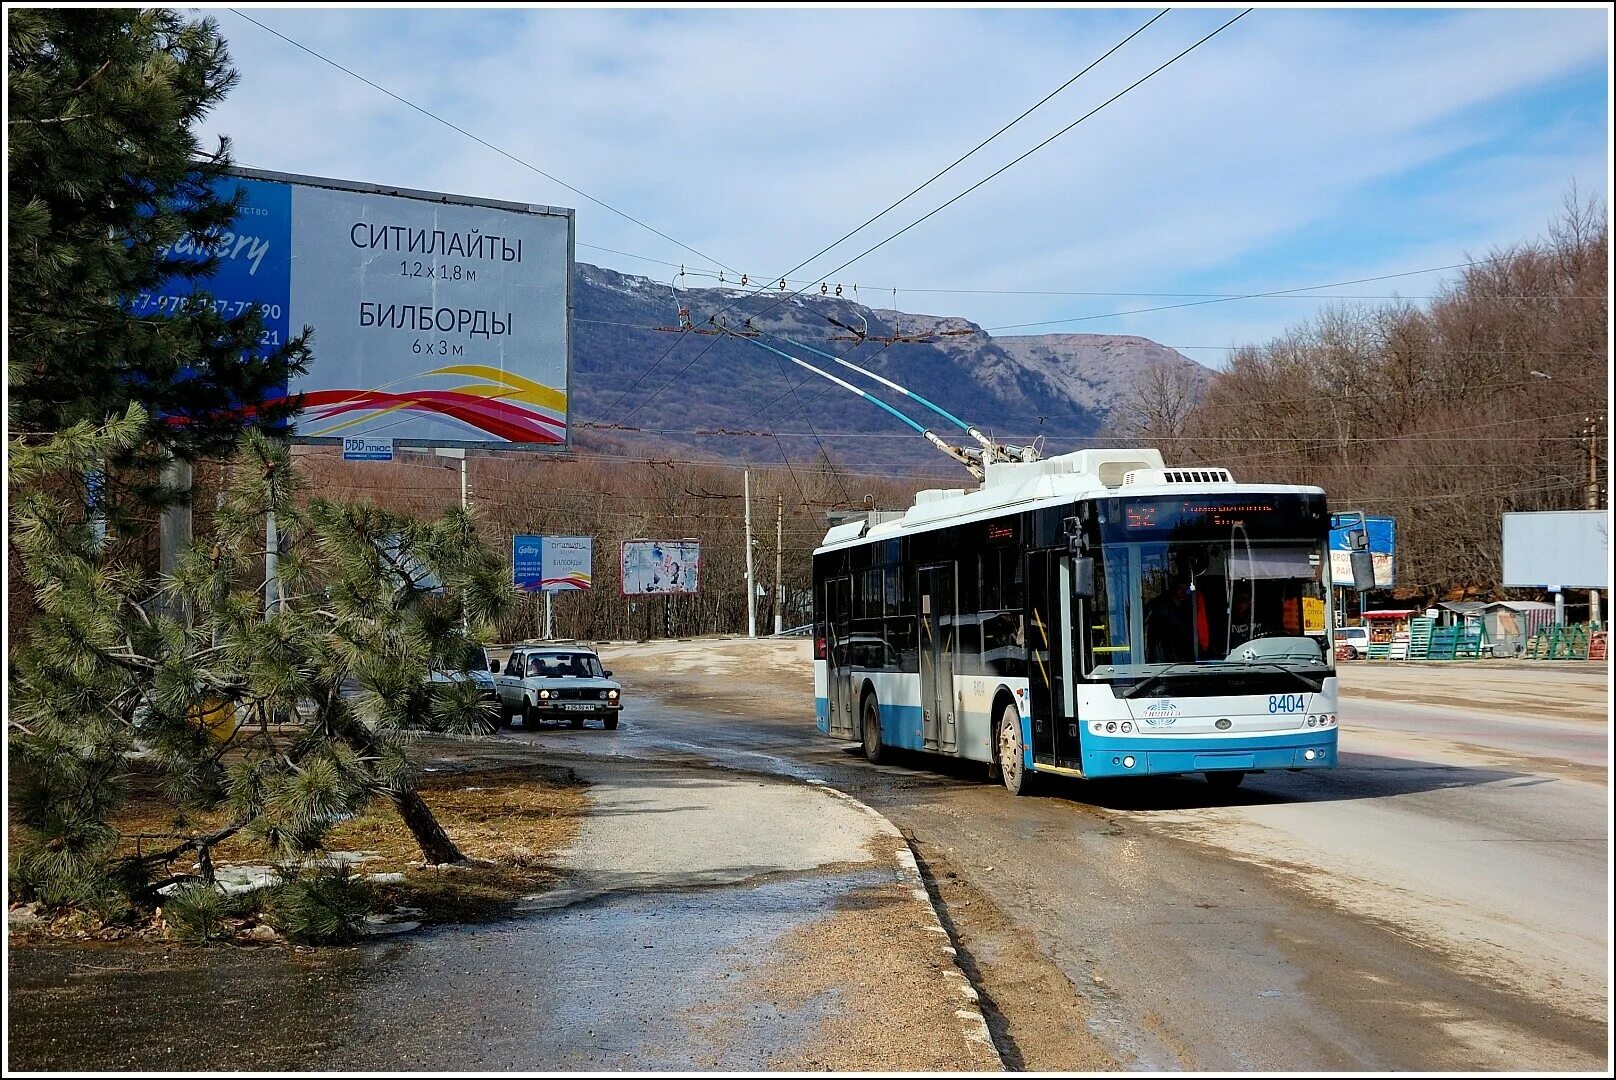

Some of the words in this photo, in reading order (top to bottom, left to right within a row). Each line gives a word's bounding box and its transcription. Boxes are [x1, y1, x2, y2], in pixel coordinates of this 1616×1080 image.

[350, 223, 522, 263] СИТИЛАЙТЫ
[400, 261, 422, 278] 1,2
[427, 265, 435, 278] х
[440, 264, 462, 282] 1,8
[466, 270, 476, 282] м
[360, 302, 512, 339] БИЛБОРДЫ
[412, 338, 421, 354] 6
[426, 342, 434, 354] х
[438, 340, 448, 355] 3
[452, 345, 463, 356] м
[1268, 694, 1305, 714] 8404
